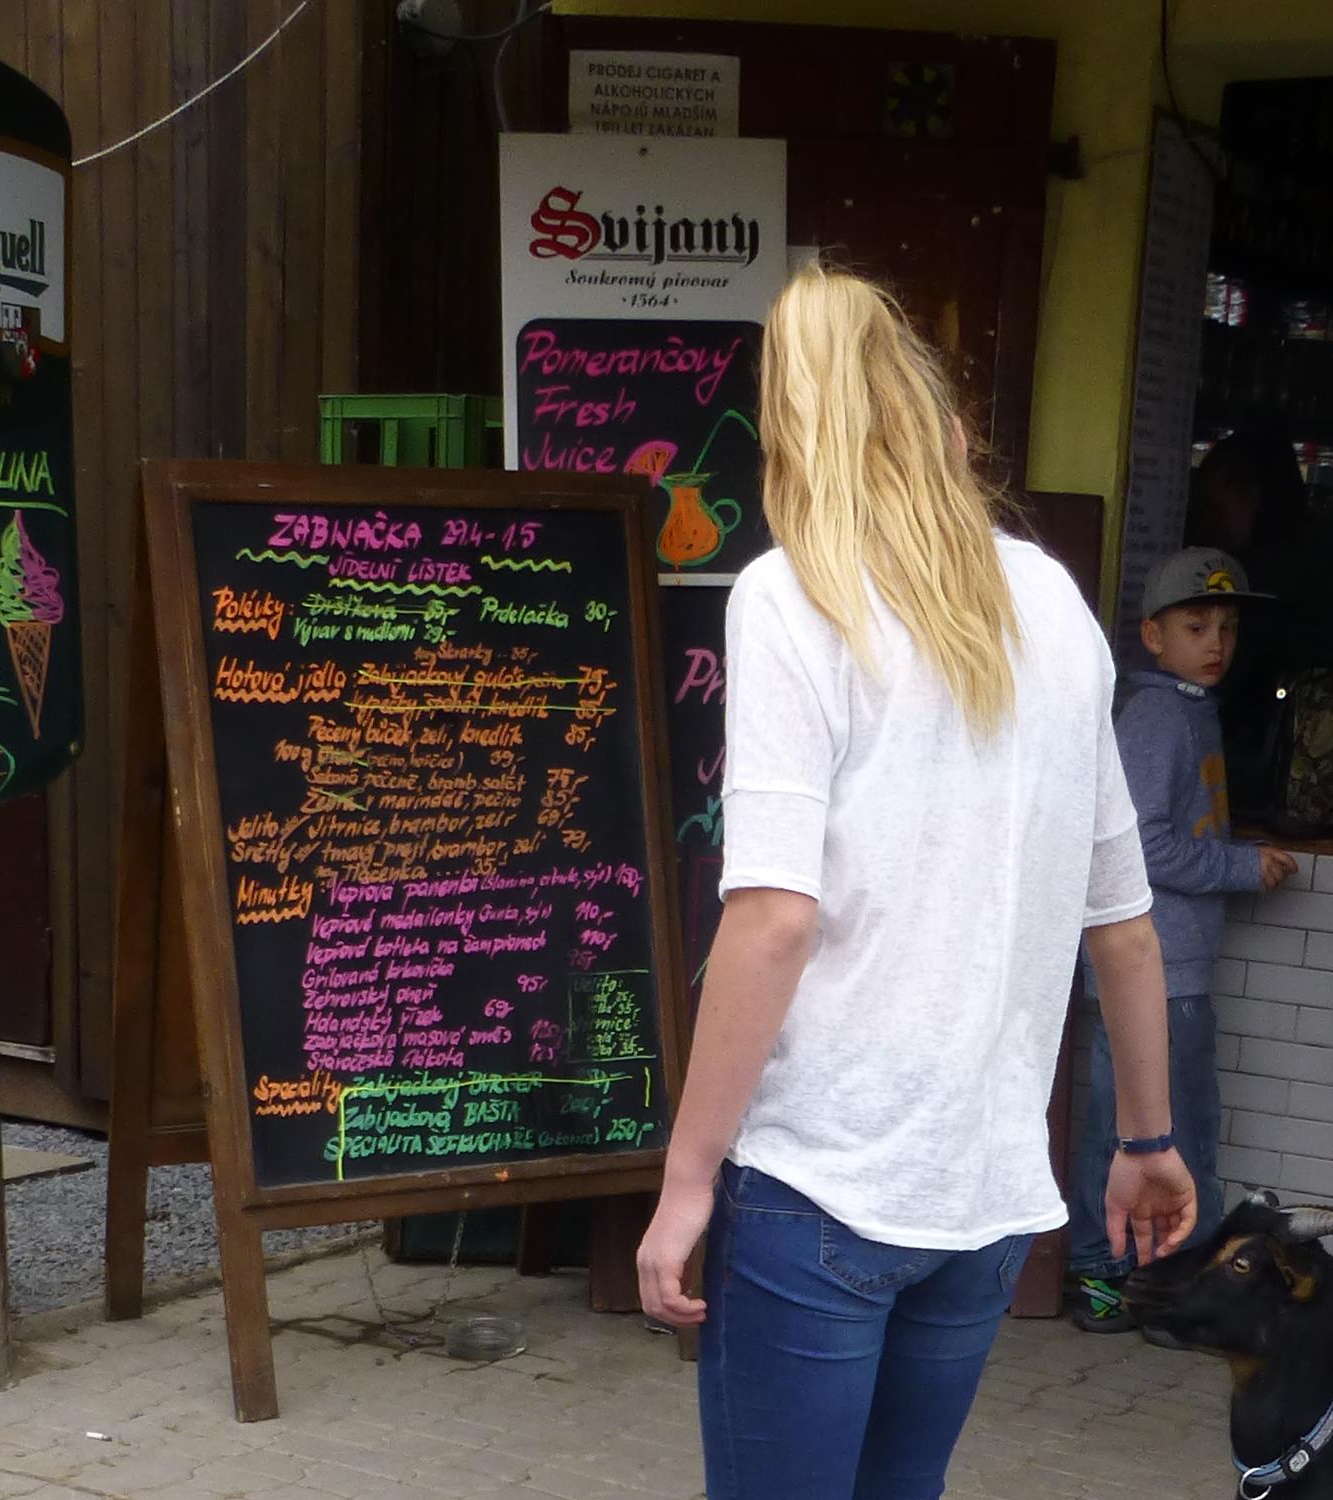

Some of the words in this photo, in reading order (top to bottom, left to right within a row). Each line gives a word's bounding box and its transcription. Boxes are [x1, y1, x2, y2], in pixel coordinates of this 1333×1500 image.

[588, 63, 642, 79] PRODEJ
[646, 65, 707, 82] CIGARET
[710, 70, 721, 83] A
[594, 84, 715, 101] ALKOHOLICKÝCH
[652, 103, 717, 121] MLADŠÍM
[528, 186, 760, 270] Svijany
[565, 268, 657, 290] Soukromý
[662, 272, 730, 291] pivovar
[519, 329, 742, 405] Pomerančový
[533, 384, 637, 427] Fresh
[523, 431, 617, 473] Juice
[268, 511, 422, 550] ZABIJAČKA
[329, 551, 403, 580] JÍDELNÍ
[585, 600, 618, 633] 30,-
[216, 655, 292, 690] Hotová
[437, 938, 459, 954] na
